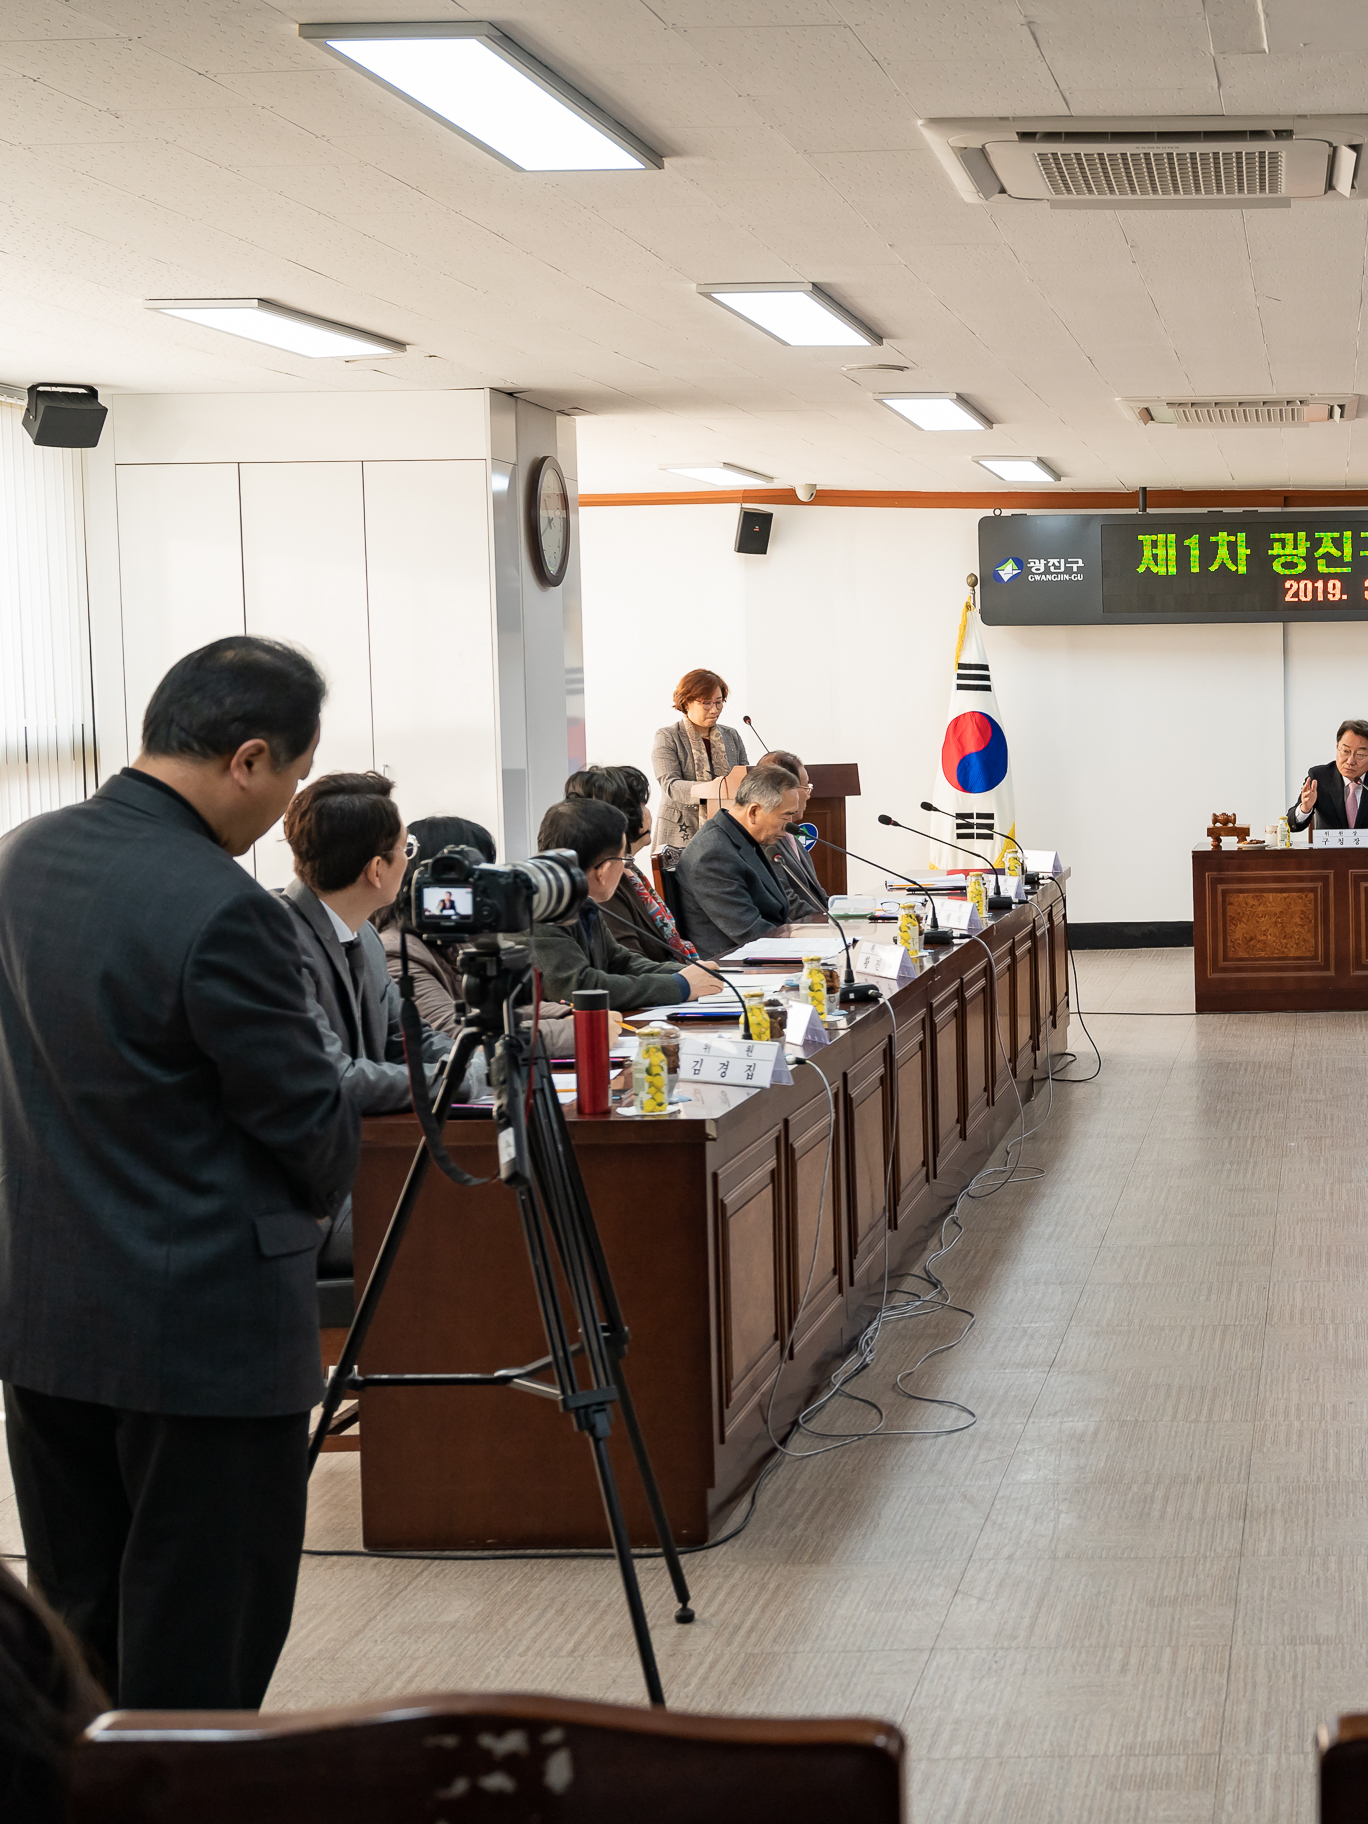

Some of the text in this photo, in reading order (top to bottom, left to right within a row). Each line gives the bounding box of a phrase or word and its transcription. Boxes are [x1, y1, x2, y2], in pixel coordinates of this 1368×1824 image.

[1136, 531, 1251, 576] 제1차
[1026, 558, 1085, 574] 광진구
[1027, 573, 1085, 582] GWANGJIN-GU
[1284, 579, 1348, 602] 2019.
